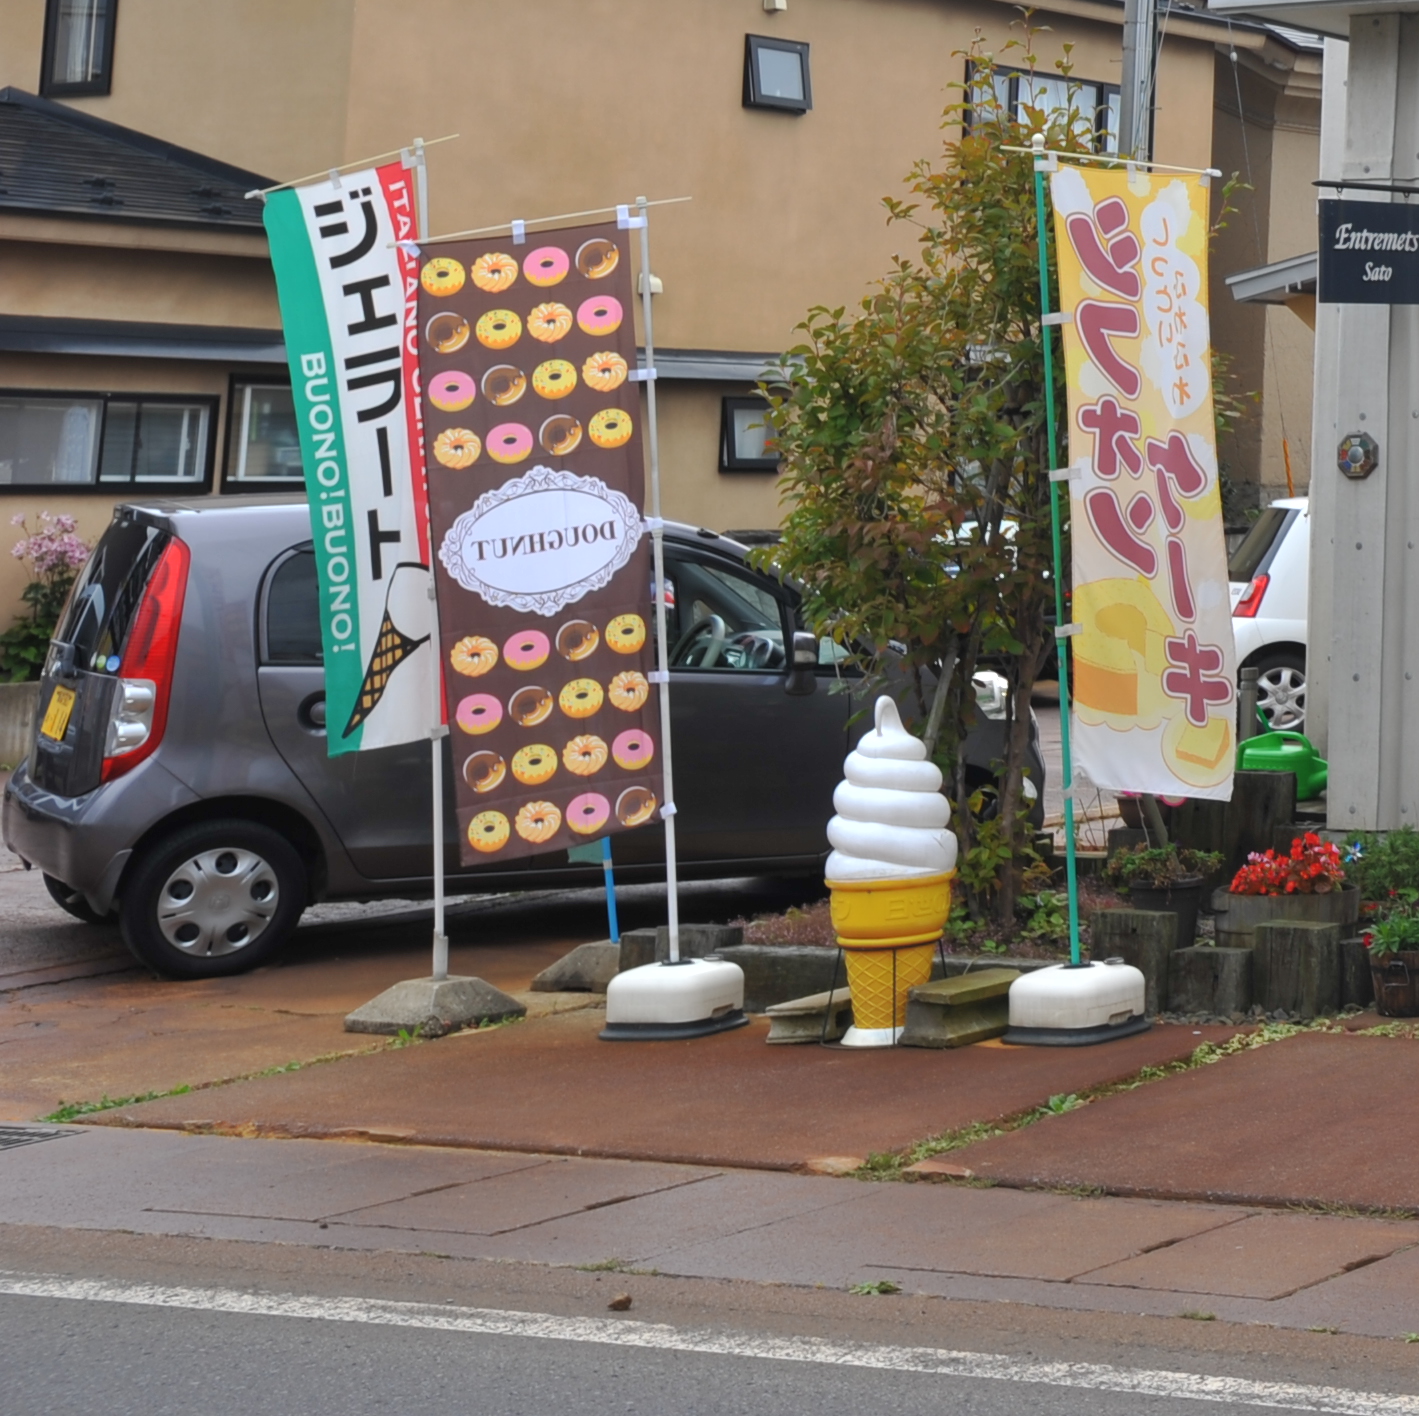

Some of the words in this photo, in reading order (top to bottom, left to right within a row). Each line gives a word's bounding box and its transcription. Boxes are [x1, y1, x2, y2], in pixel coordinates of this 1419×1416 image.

[1334, 222, 1419, 252] Entremets
[1362, 262, 1393, 282] Sato
[314, 186, 402, 581] ジェラート
